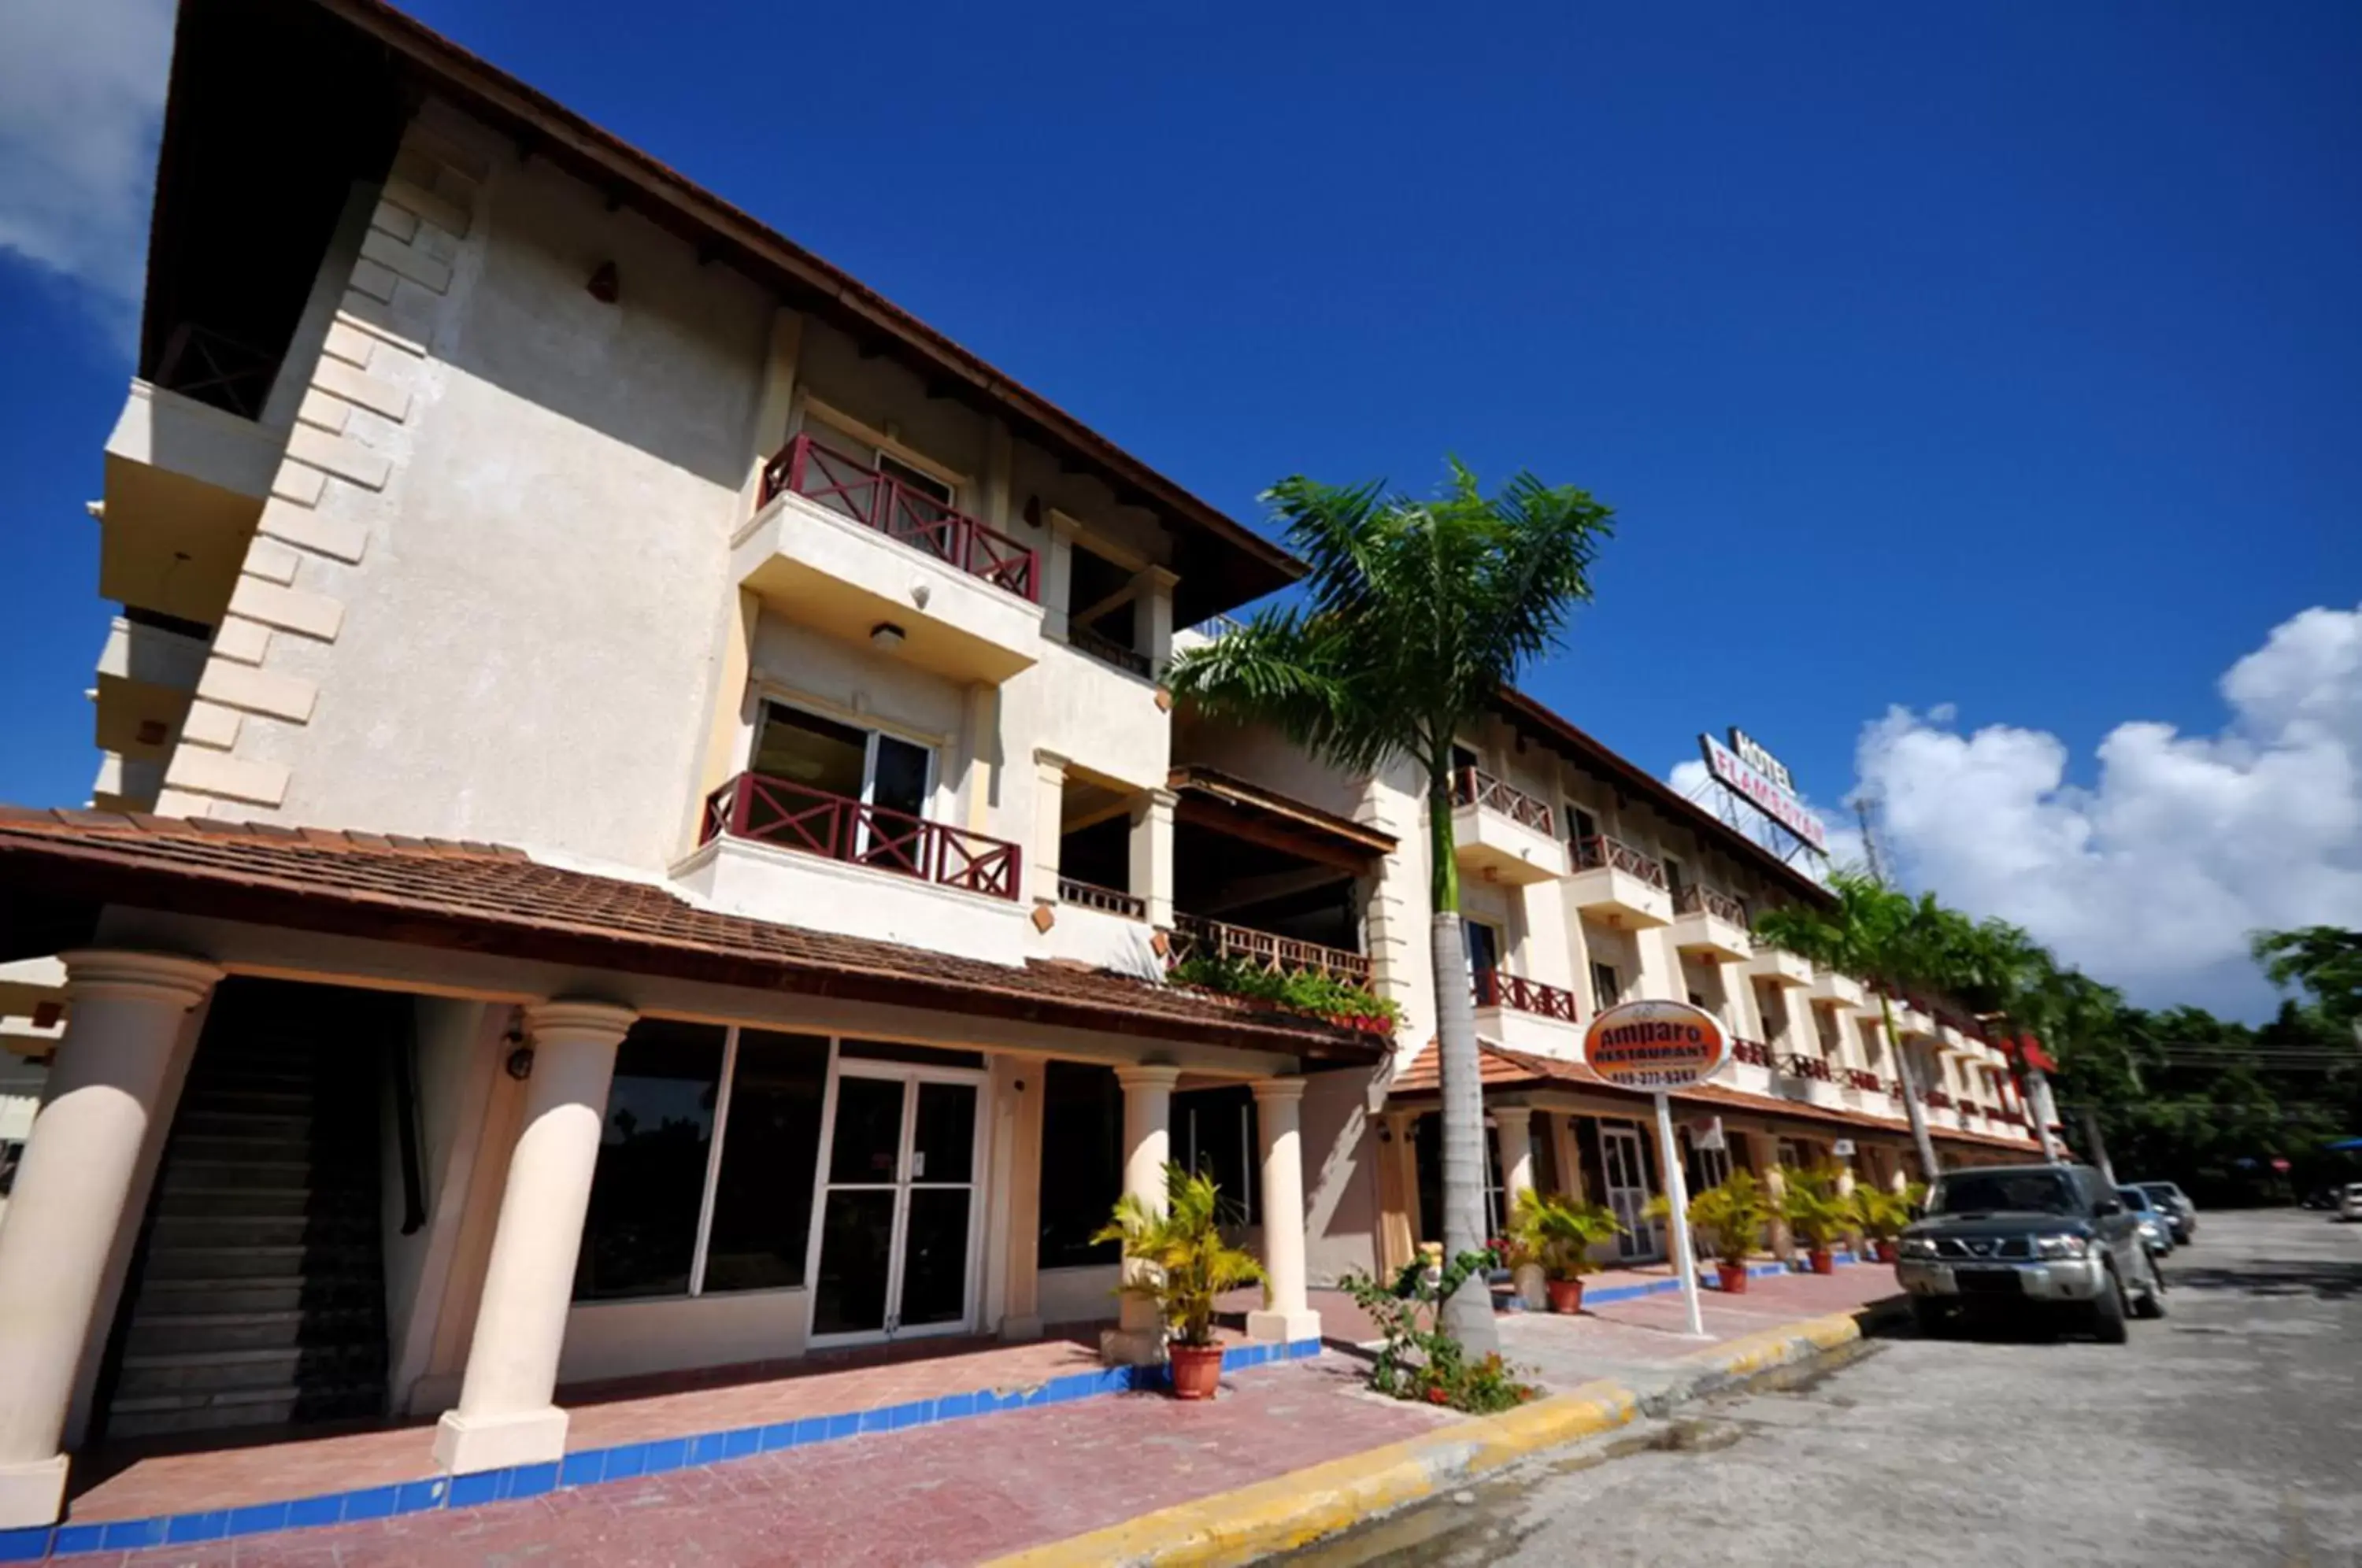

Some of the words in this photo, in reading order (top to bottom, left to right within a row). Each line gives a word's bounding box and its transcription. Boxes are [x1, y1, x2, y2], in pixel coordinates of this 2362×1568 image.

[1735, 728, 1796, 797] HOTEL
[1601, 1022, 1701, 1048] Amparo
[1595, 1045, 1709, 1063] RESTAURANT
